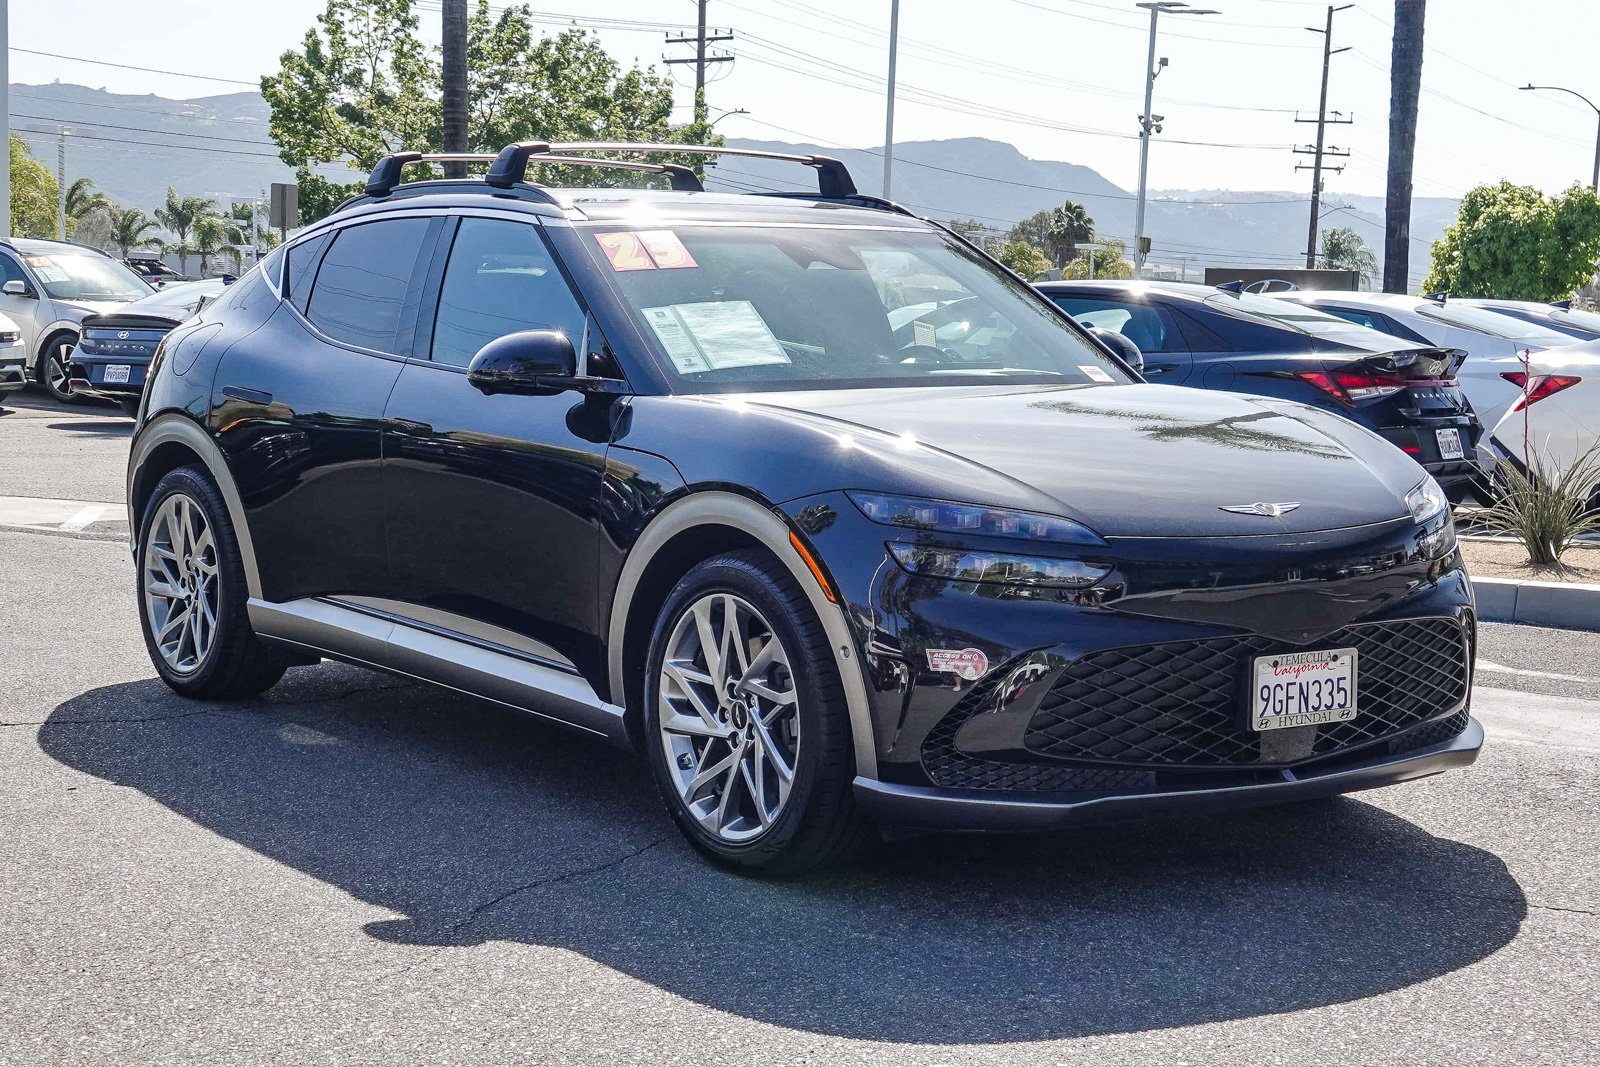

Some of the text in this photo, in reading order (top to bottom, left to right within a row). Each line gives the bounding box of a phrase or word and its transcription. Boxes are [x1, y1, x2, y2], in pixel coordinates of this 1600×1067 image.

[1279, 651, 1333, 666] TEMECULA
[1260, 677, 1348, 718] 9GFN335
[1278, 711, 1332, 727] HYUNDAI
